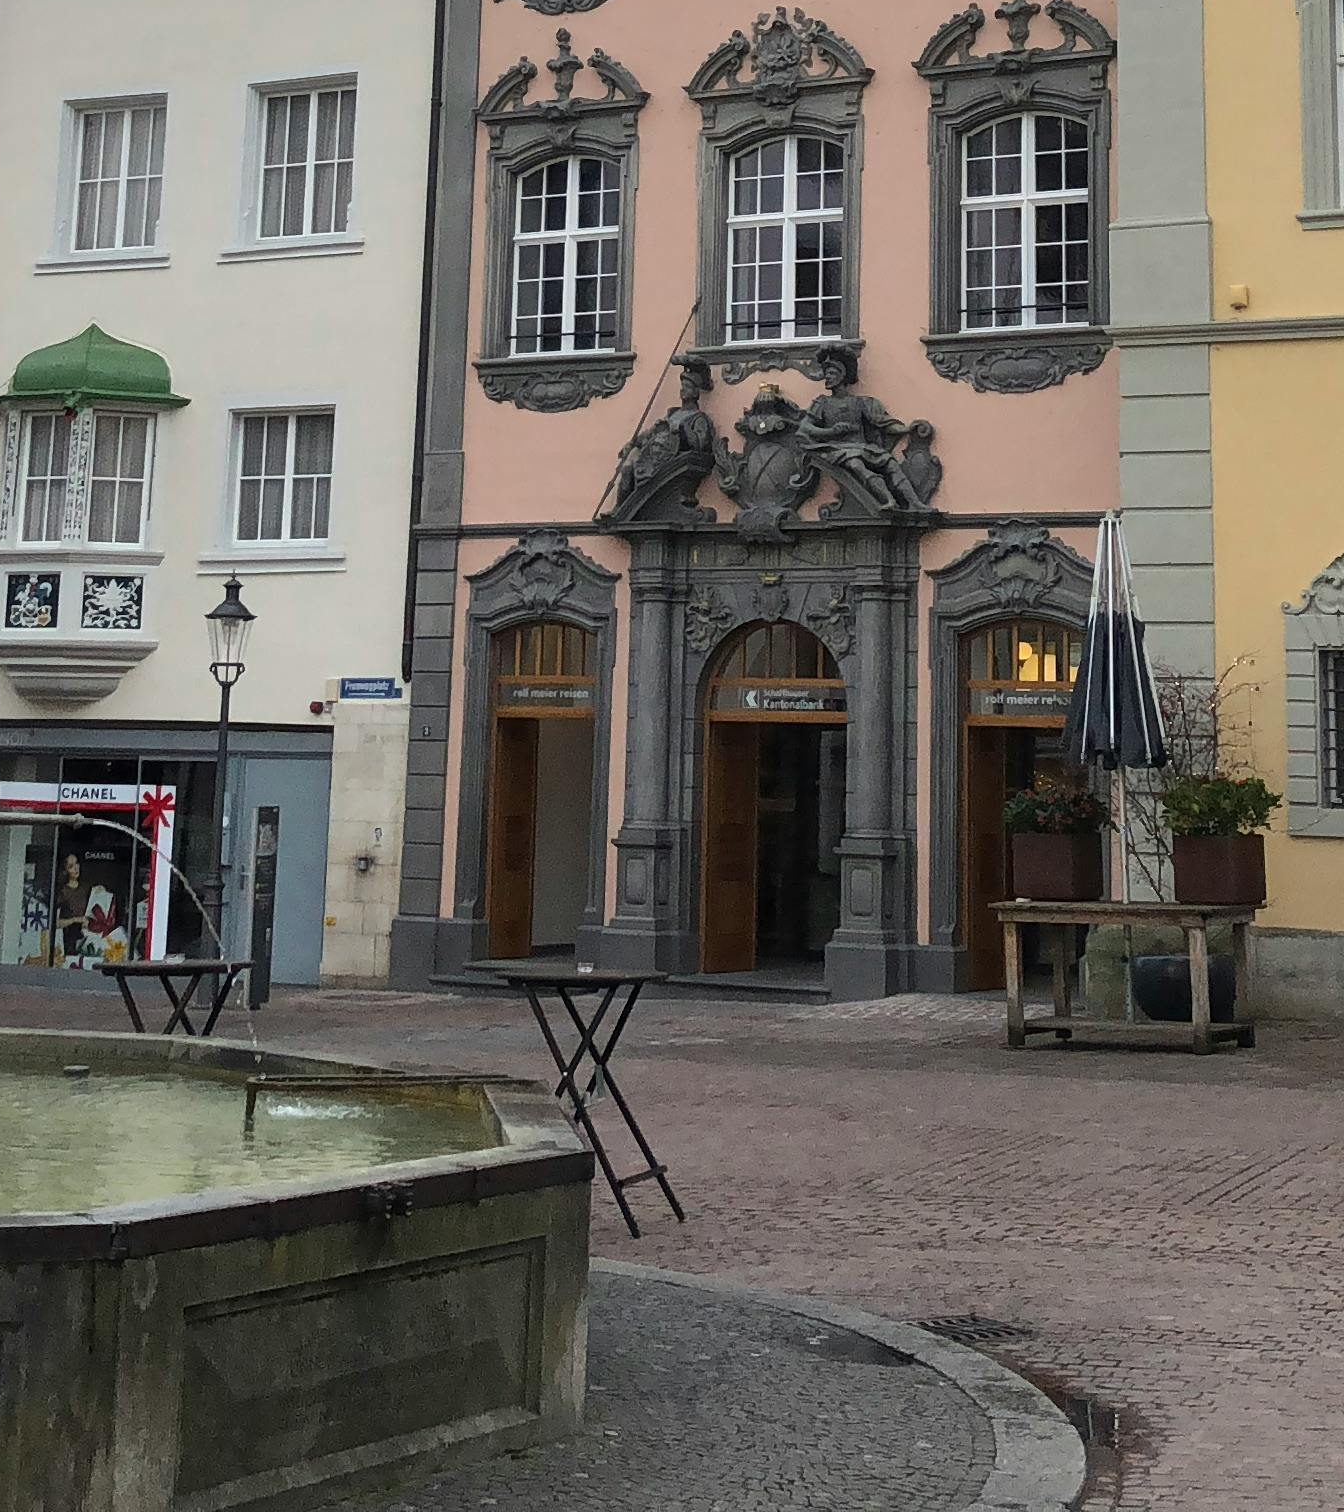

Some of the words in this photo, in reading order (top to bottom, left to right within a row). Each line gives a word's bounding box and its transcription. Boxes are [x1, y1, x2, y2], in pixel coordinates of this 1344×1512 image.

[513, 688, 529, 698] rolf
[530, 688, 557, 698] meier
[559, 688, 589, 698] reisen
[985, 692, 1004, 704] rolf
[1006, 694, 1040, 705] meier
[763, 698, 825, 710] Kantonalbank
[61, 787, 117, 801] CHANEL
[84, 851, 115, 860] CHANEL
